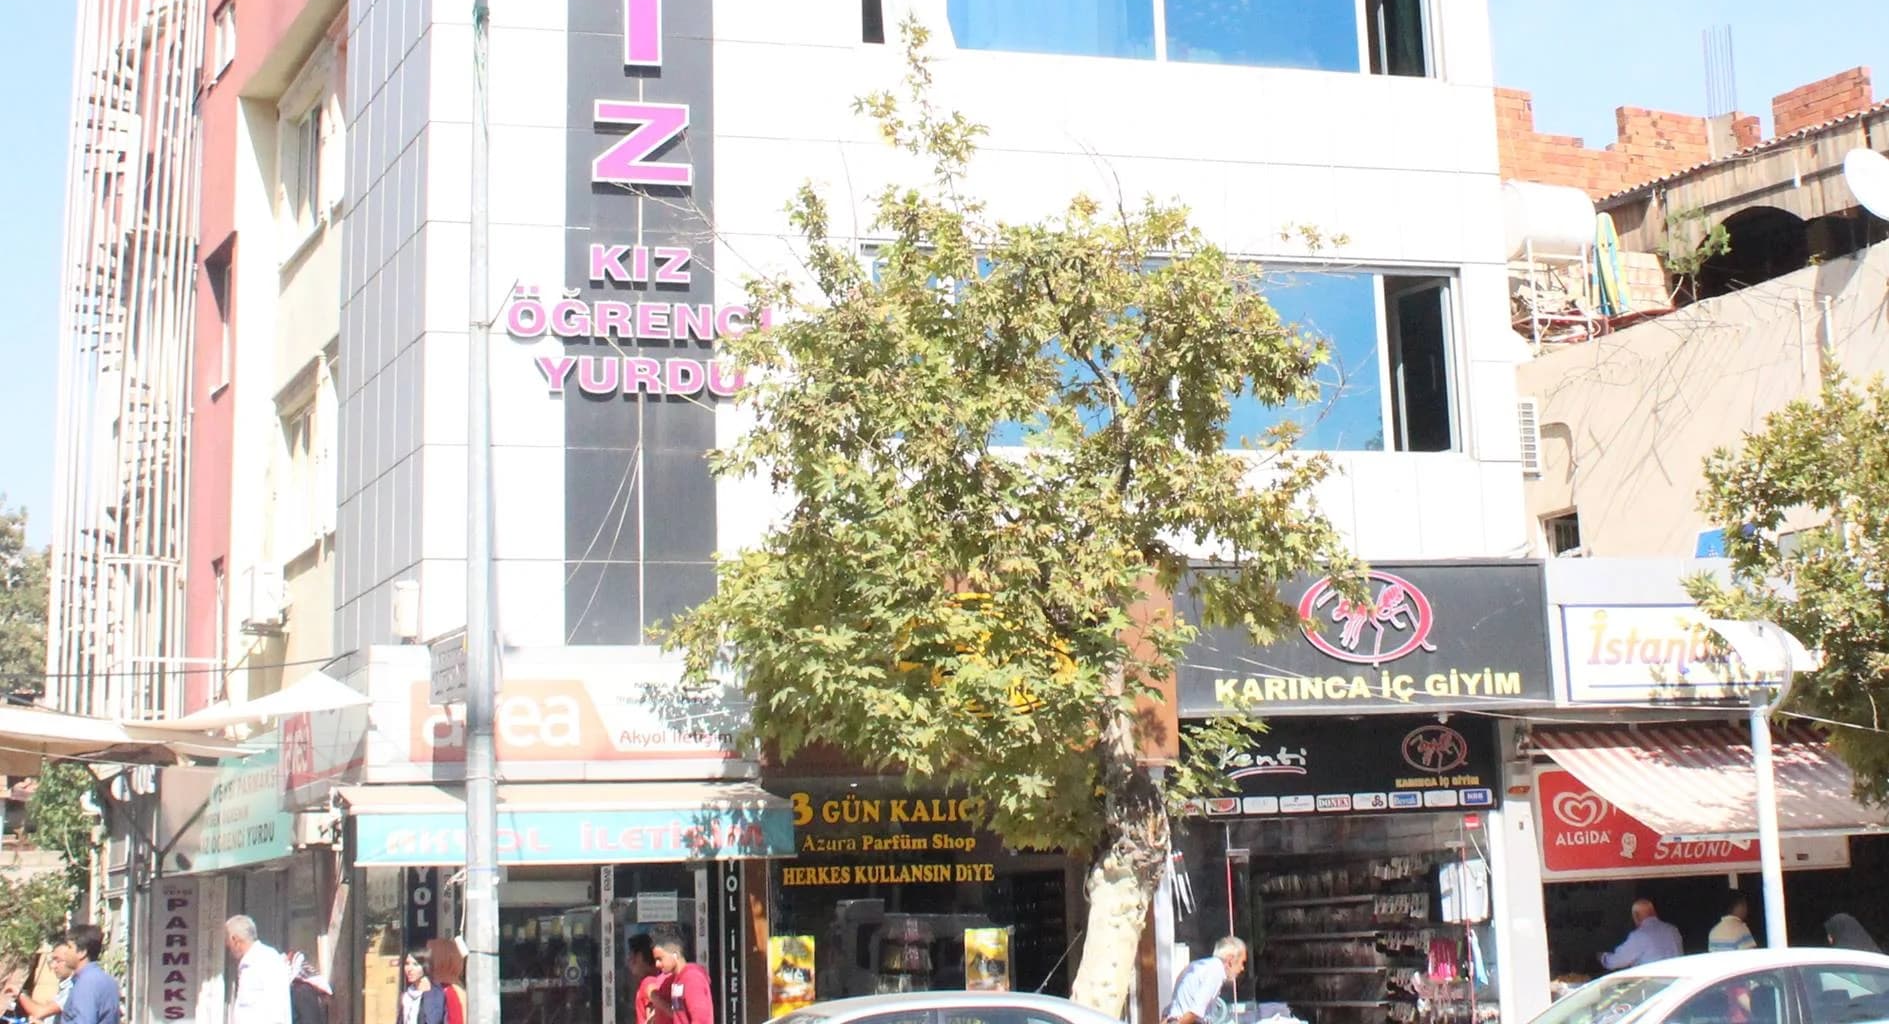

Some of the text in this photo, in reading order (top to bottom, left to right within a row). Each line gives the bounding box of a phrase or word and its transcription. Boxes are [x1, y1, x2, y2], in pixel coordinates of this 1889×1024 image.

[589, 242, 691, 290] KIZ
[535, 354, 747, 404] YURDU
[1215, 667, 1521, 702] KARINCA İÇ GİYİM
[421, 695, 580, 747] aea
[789, 792, 814, 825] 3
[822, 794, 880, 824] GÜN
[801, 831, 977, 853] Azura Parfüm Shop
[783, 866, 850, 886] HERKES
[854, 863, 951, 885] KULLANSIN
